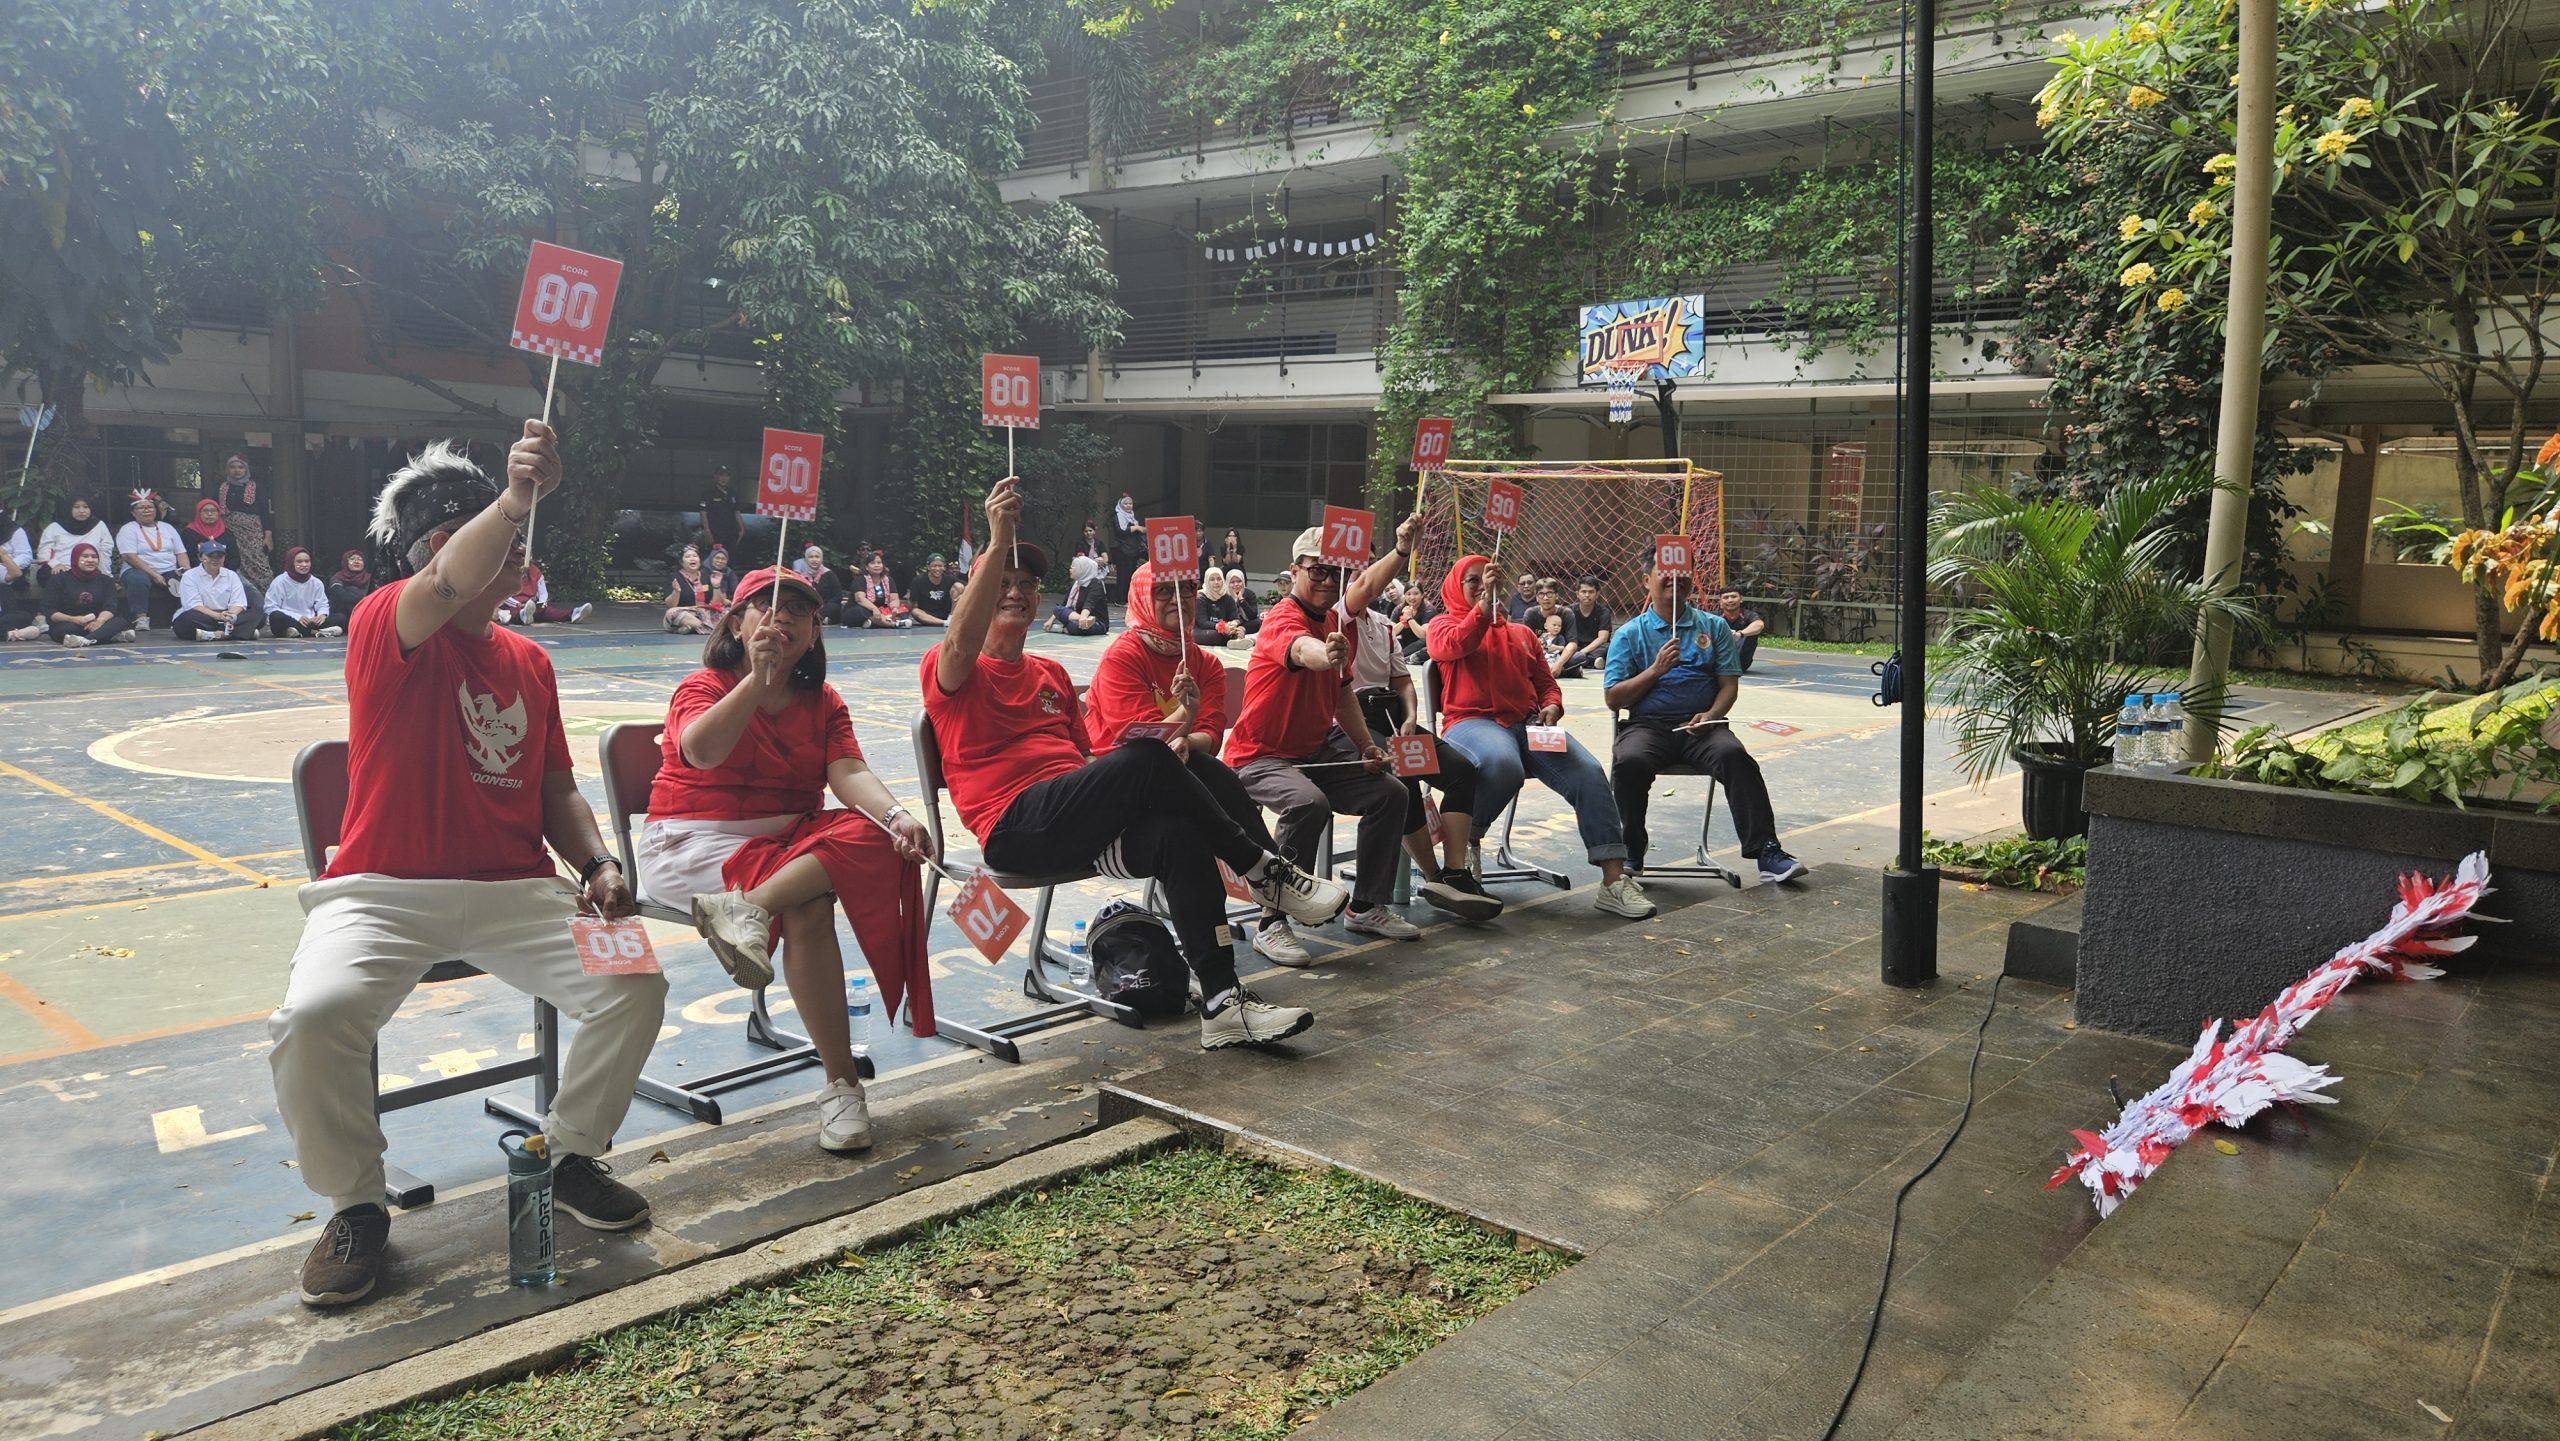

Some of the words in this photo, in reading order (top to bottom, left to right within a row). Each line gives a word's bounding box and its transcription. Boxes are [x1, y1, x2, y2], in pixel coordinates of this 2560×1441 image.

[560, 264, 589, 277] SCORE
[532, 272, 599, 331] 80
[991, 372, 1030, 407] 80
[1419, 432, 1444, 457] 80
[767, 452, 811, 494] 90
[1490, 493, 1515, 519] 90
[1155, 533, 1189, 564] 80
[1329, 522, 1363, 552] 70
[1661, 545, 1686, 566] 80
[1126, 727, 1168, 739] 90
[1401, 740, 1426, 768] 90
[966, 888, 1010, 941] 70
[587, 929, 645, 959] 90
[538, 1189, 551, 1259] SPORT
